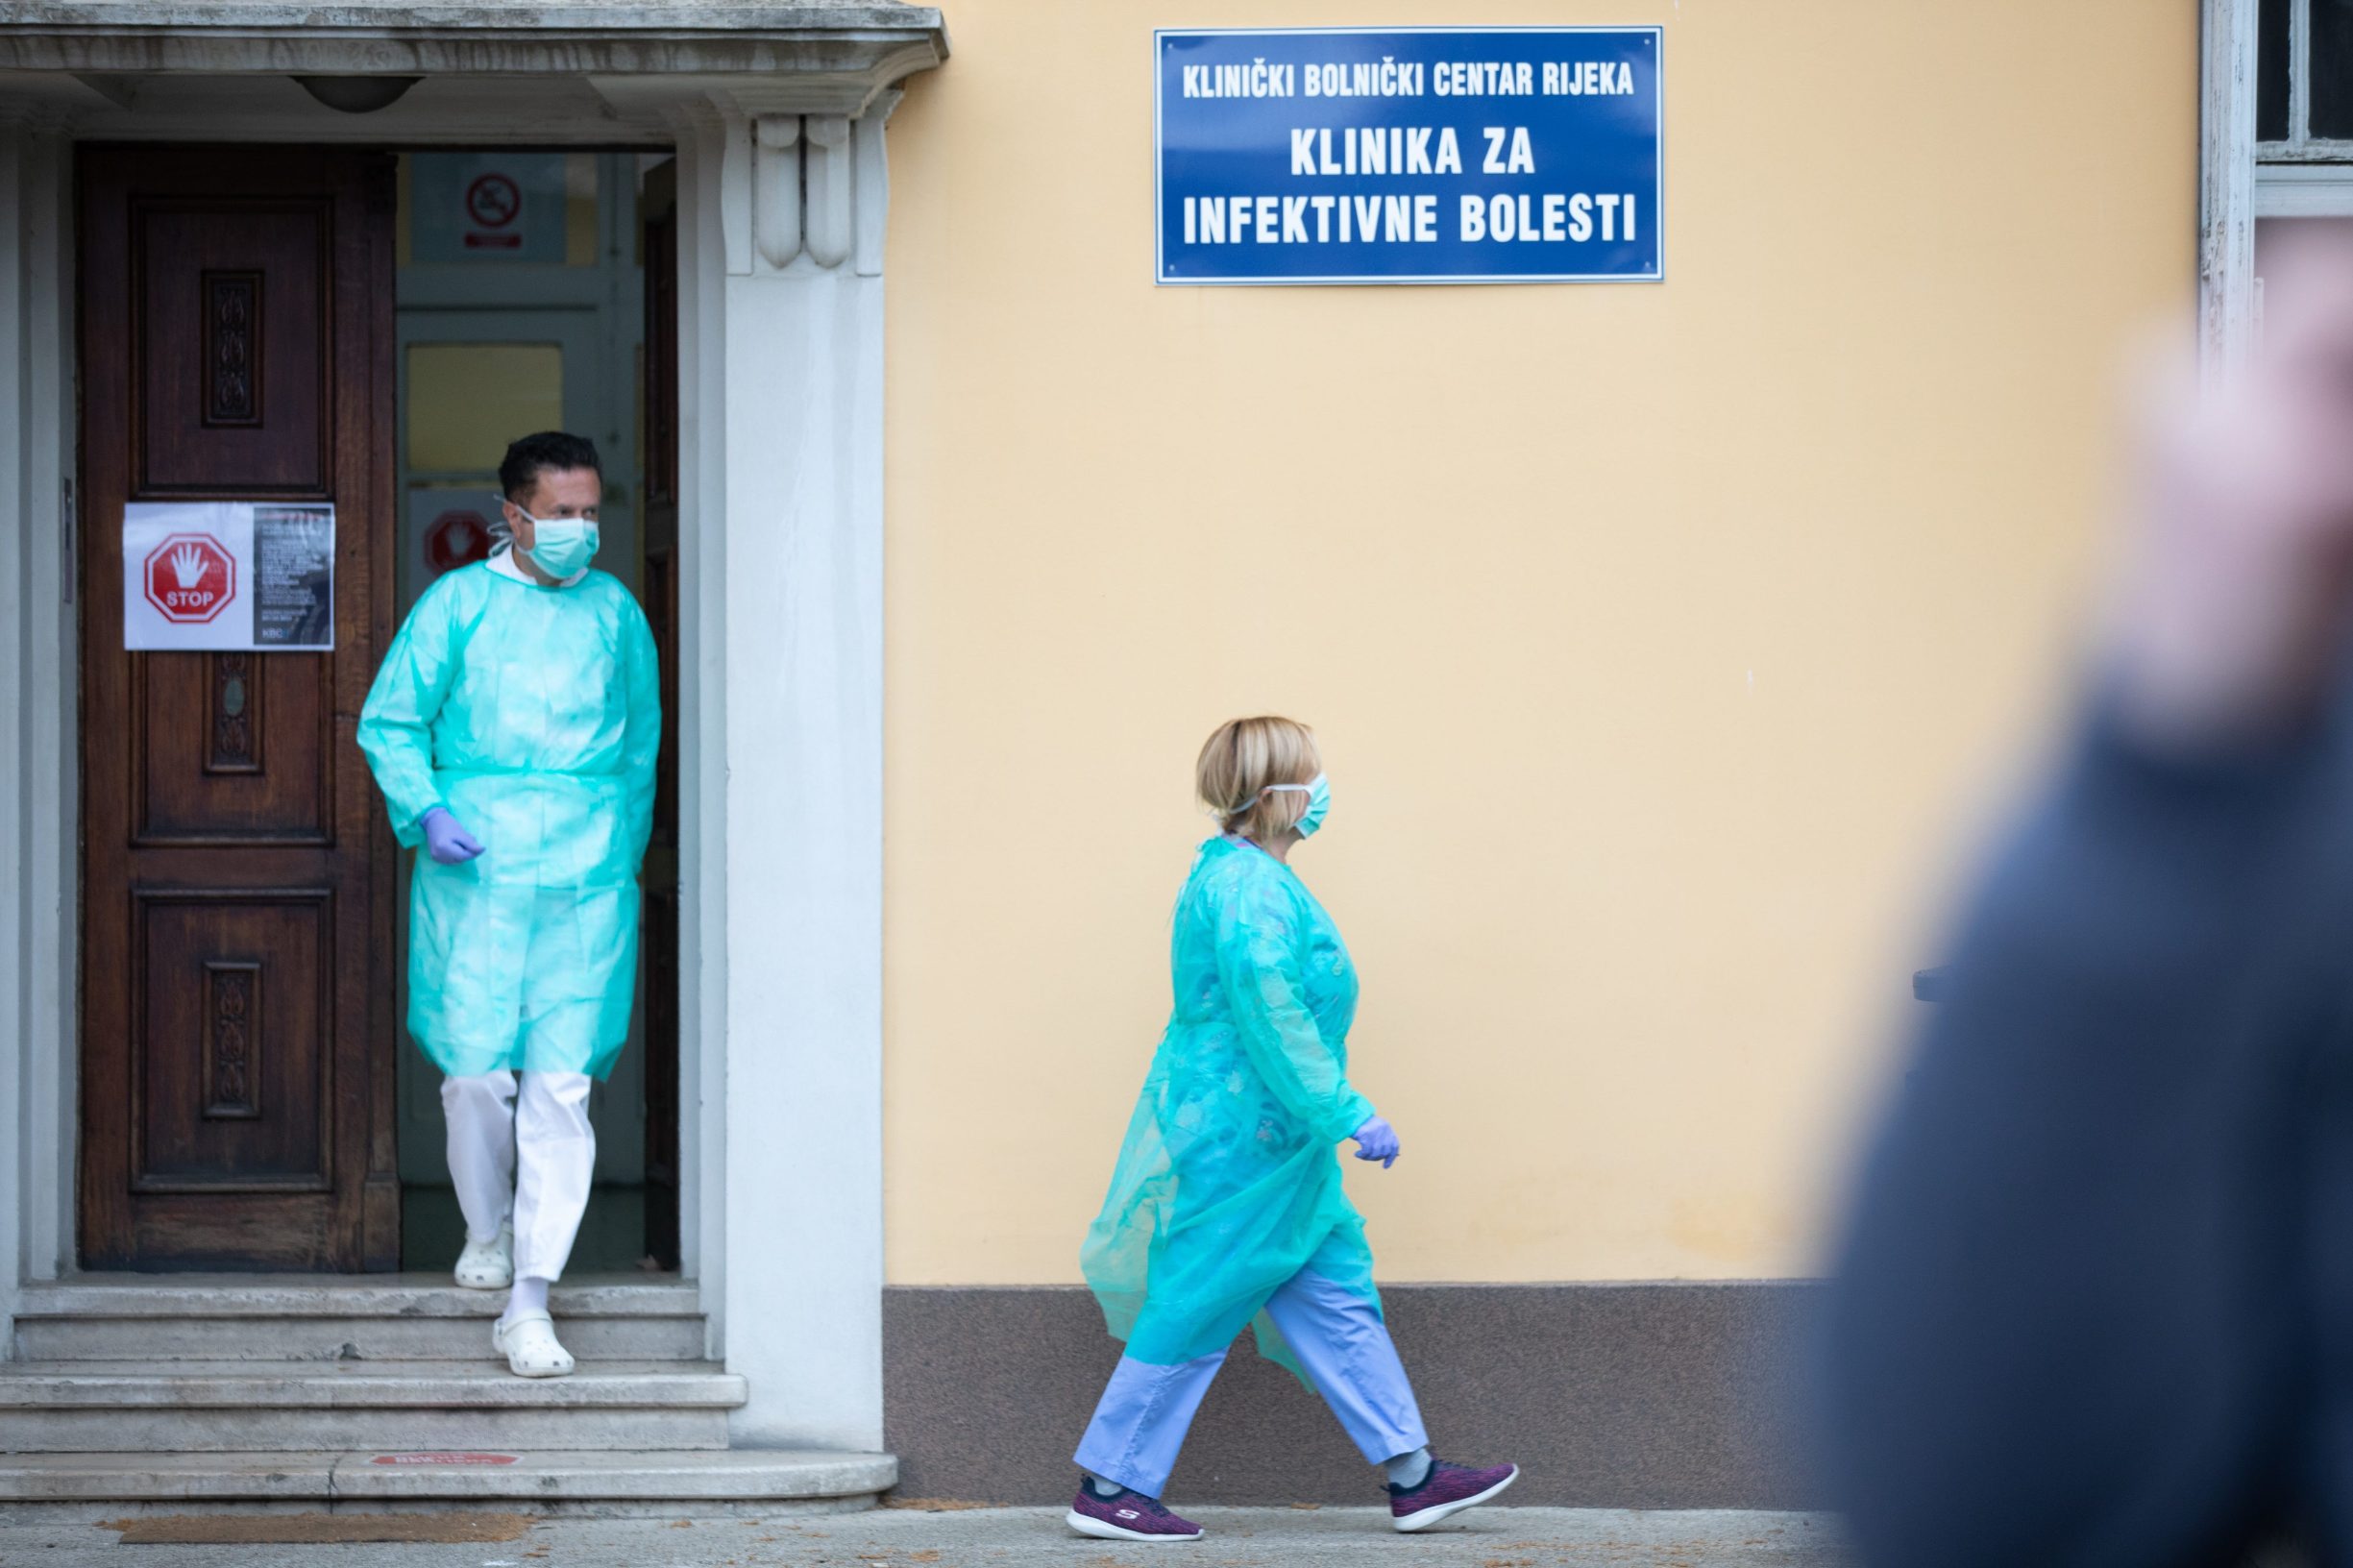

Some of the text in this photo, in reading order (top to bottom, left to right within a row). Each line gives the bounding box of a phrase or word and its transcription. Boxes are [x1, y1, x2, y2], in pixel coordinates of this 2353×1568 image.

[1183, 57, 1634, 98] KLINIČKI BOLNIČKI CENTAR RIJEKA
[1290, 127, 1534, 175] KLINIKA ZA
[1184, 193, 1635, 244] INFEKTIVNE BOLESTI
[166, 591, 214, 607] STOP
